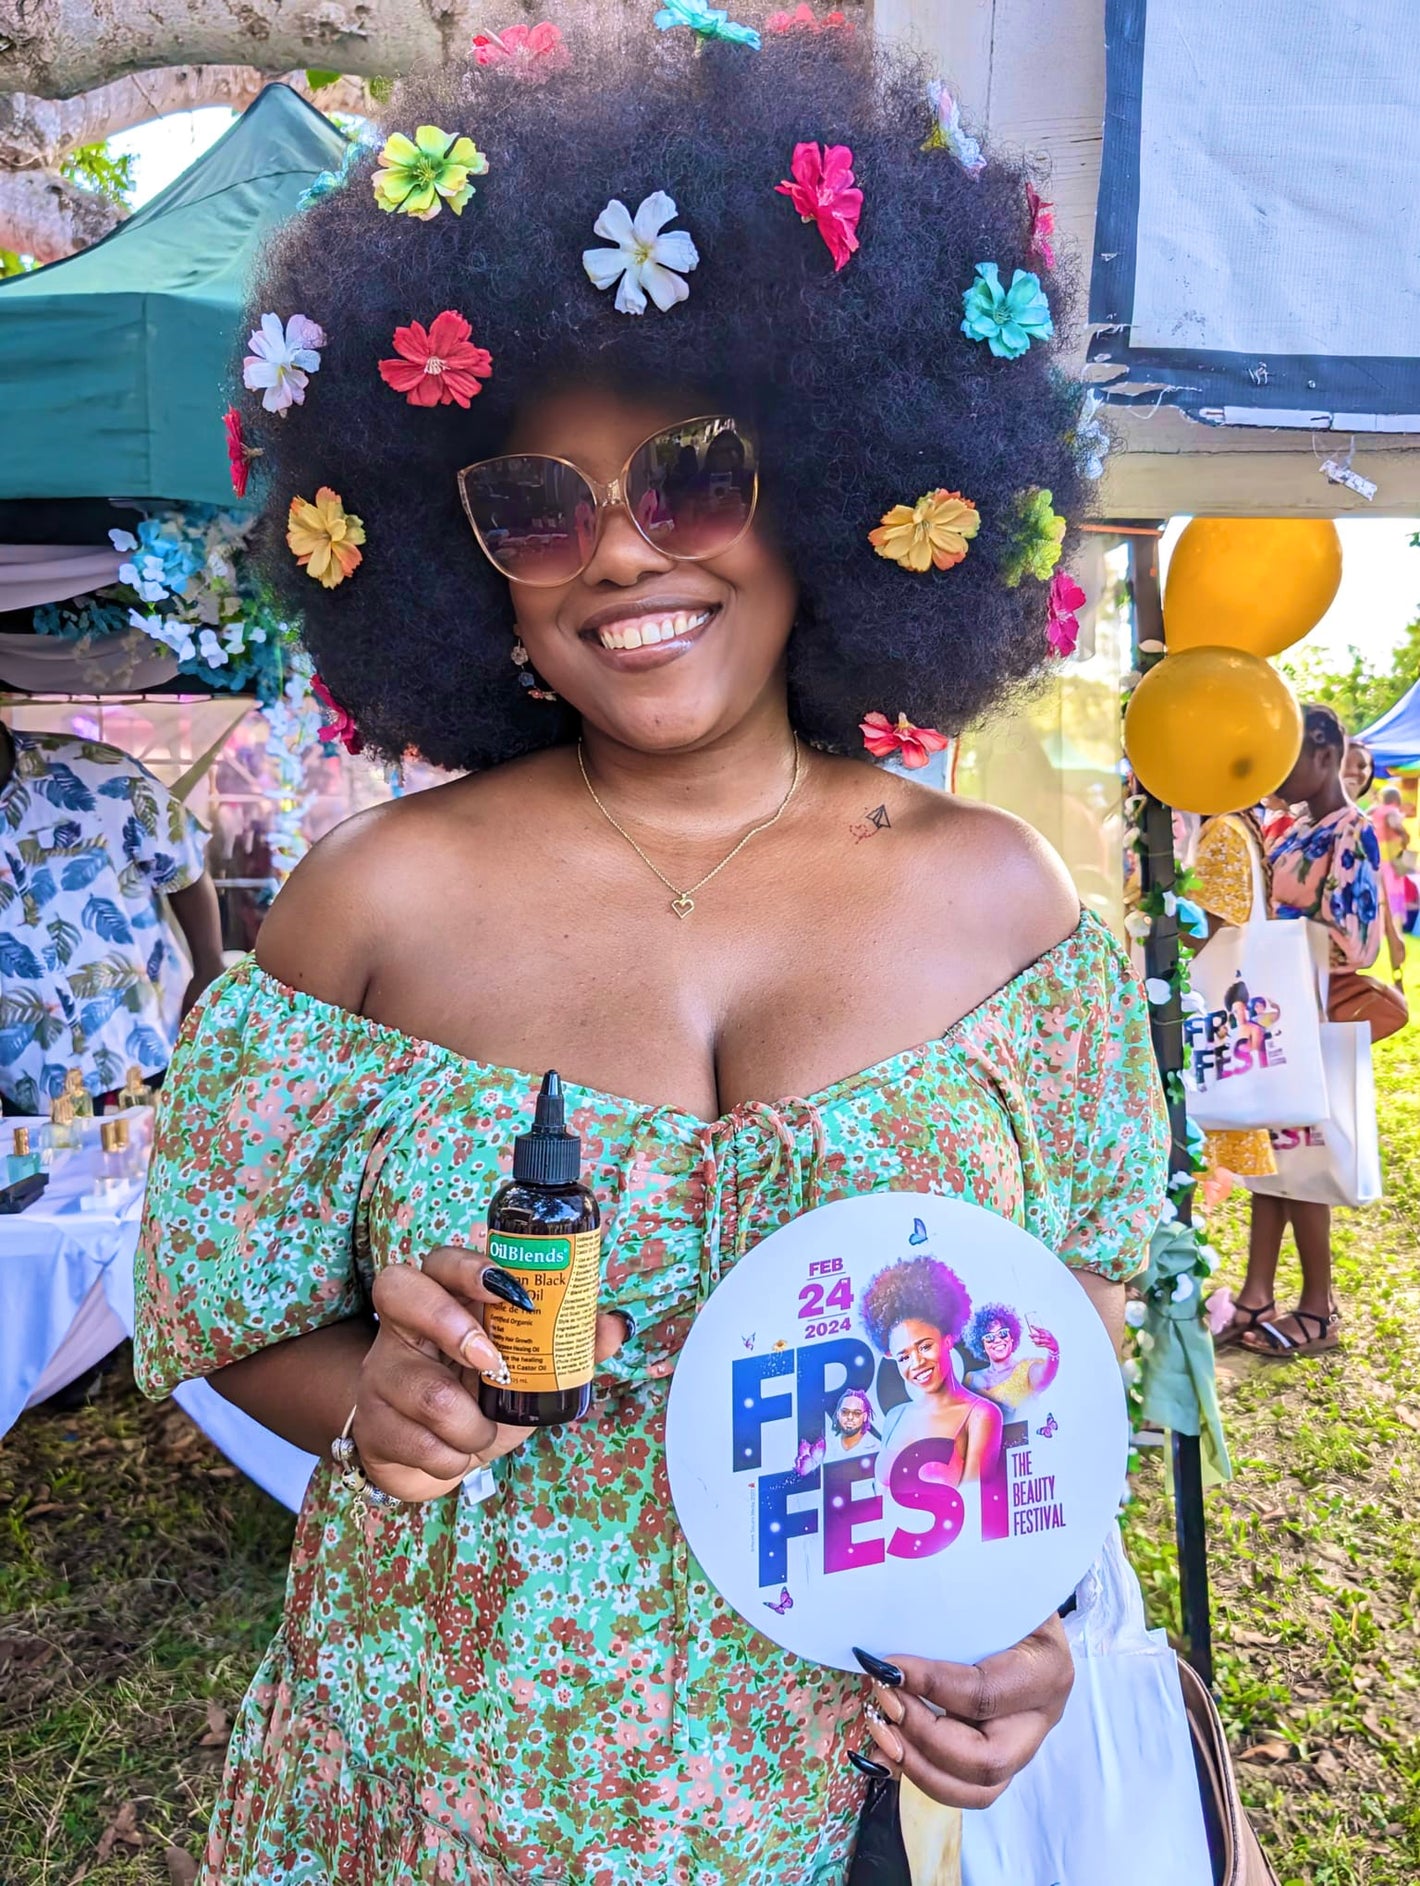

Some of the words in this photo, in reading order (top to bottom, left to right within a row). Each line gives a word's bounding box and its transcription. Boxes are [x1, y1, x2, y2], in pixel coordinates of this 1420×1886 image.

[490, 1241, 564, 1263] OilBlends
[534, 1272, 566, 1286] Black
[808, 1257, 844, 1277] FEB
[798, 1276, 854, 1319] 24
[805, 1317, 851, 1339] 2024
[1011, 1450, 1033, 1478] THE
[758, 1420, 1031, 1588] FEST
[1013, 1475, 1055, 1507] BEAUTY
[1014, 1502, 1066, 1536] FESTIVAL
